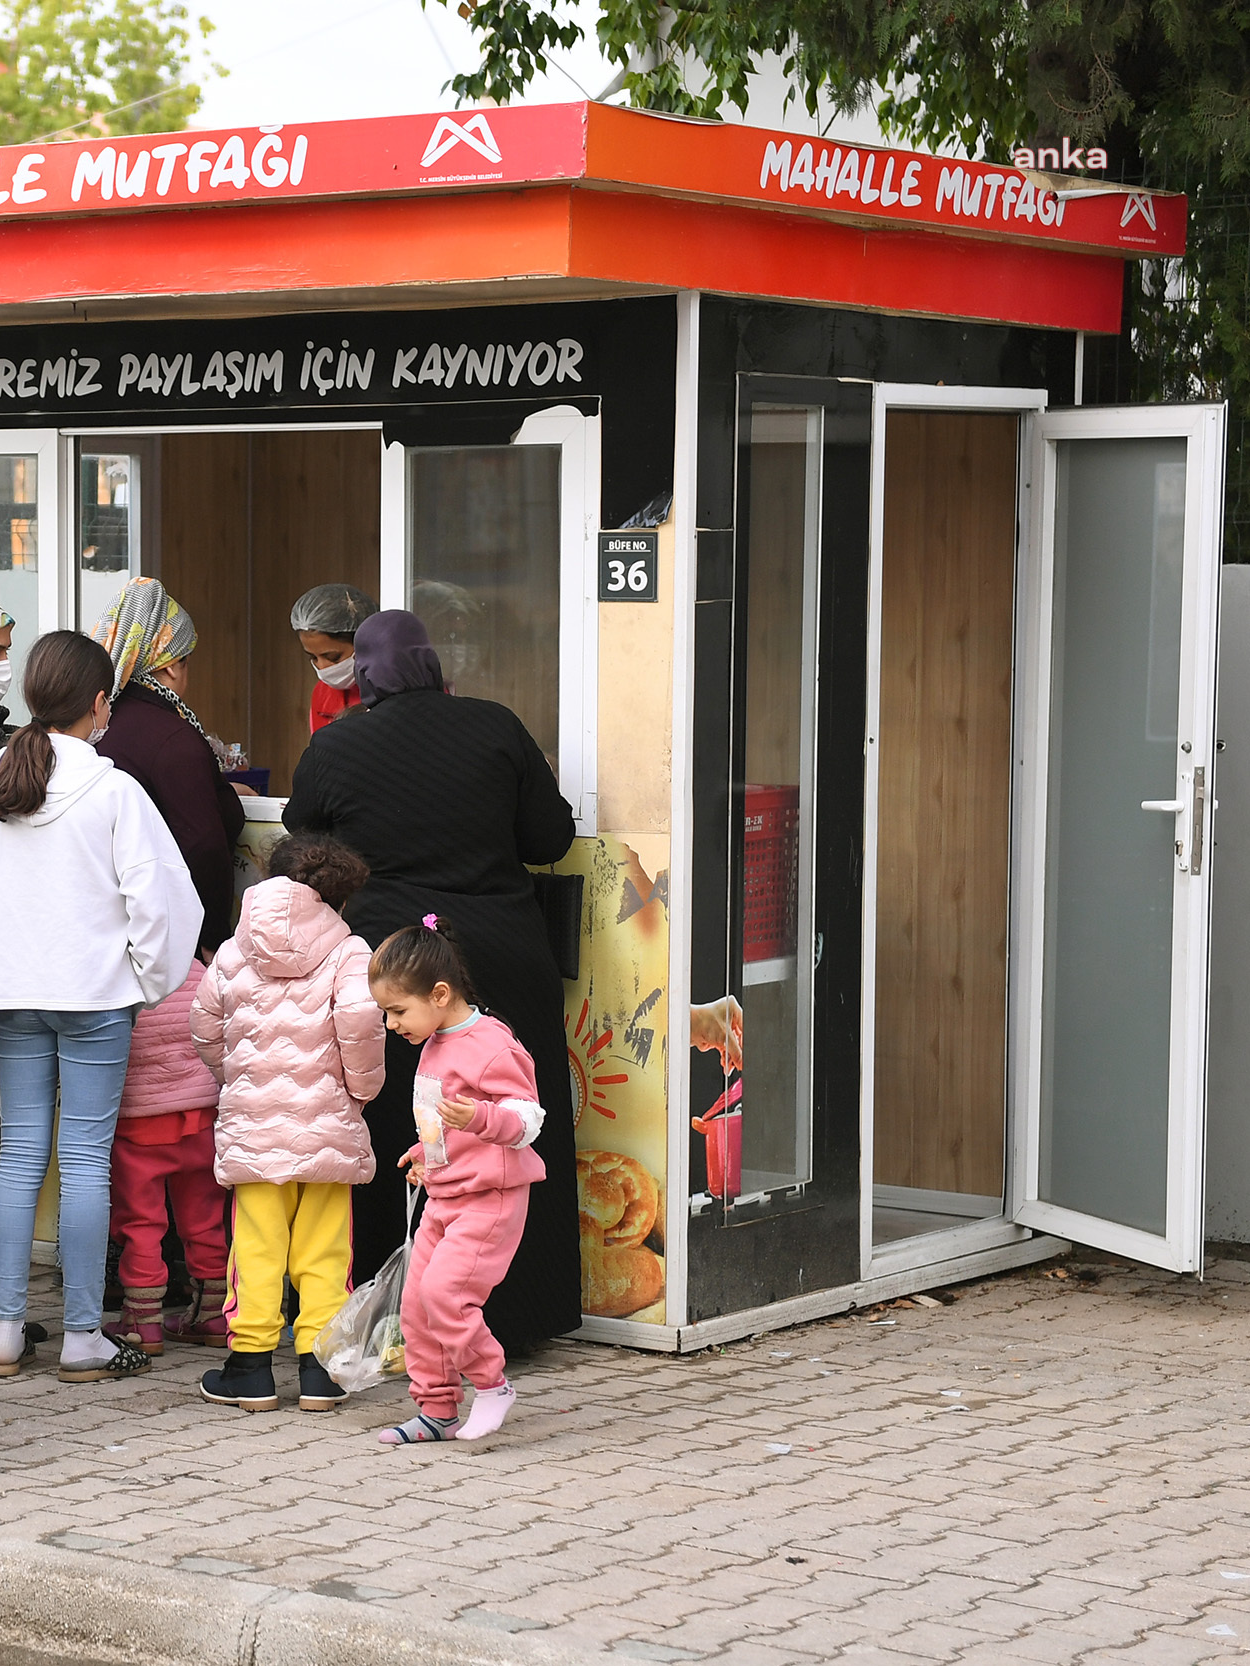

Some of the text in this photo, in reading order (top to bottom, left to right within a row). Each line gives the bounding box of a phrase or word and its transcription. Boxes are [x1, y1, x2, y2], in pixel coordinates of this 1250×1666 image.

[71, 124, 308, 202] MUTFAĞI
[760, 140, 922, 207] MAHALLE
[118, 349, 285, 399] PAYLAŞIM
[300, 339, 376, 396] İÇİN
[392, 338, 584, 389] KAYNIYOR
[608, 539, 647, 550] BÜFE NO
[607, 560, 648, 591] 36
